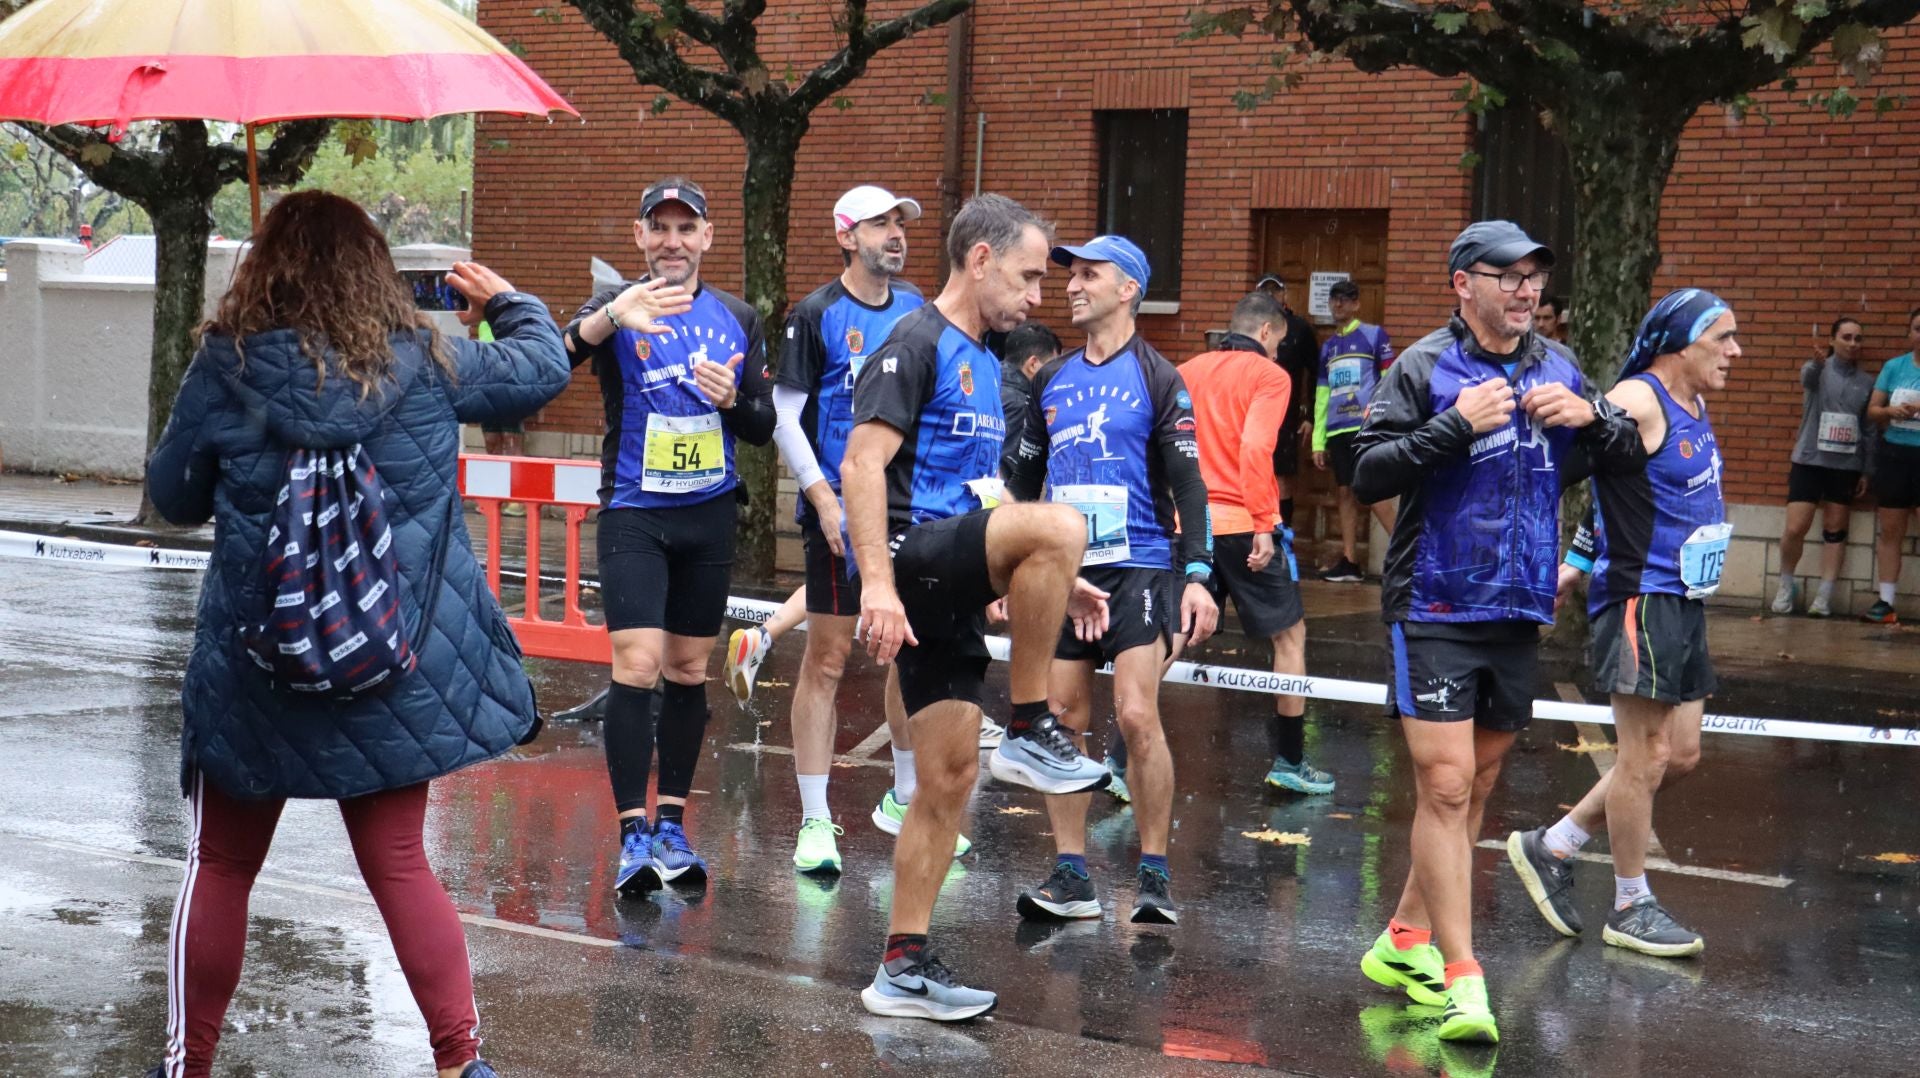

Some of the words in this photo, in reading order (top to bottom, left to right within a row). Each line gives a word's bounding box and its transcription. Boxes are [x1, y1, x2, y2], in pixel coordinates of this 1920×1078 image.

[1326, 219, 1338, 234] 6
[659, 325, 736, 351] ASTORGA
[642, 363, 687, 384] RUNNING
[1334, 370, 1352, 387] 209
[1066, 386, 1140, 409] ASTORGA
[1470, 427, 1519, 457] RUNNING
[672, 442, 702, 471] 54
[675, 478, 712, 487] HYUNDAI
[50, 545, 105, 561] kutxabank
[334, 642, 356, 658] adidas
[1217, 669, 1315, 694] kutxabank
